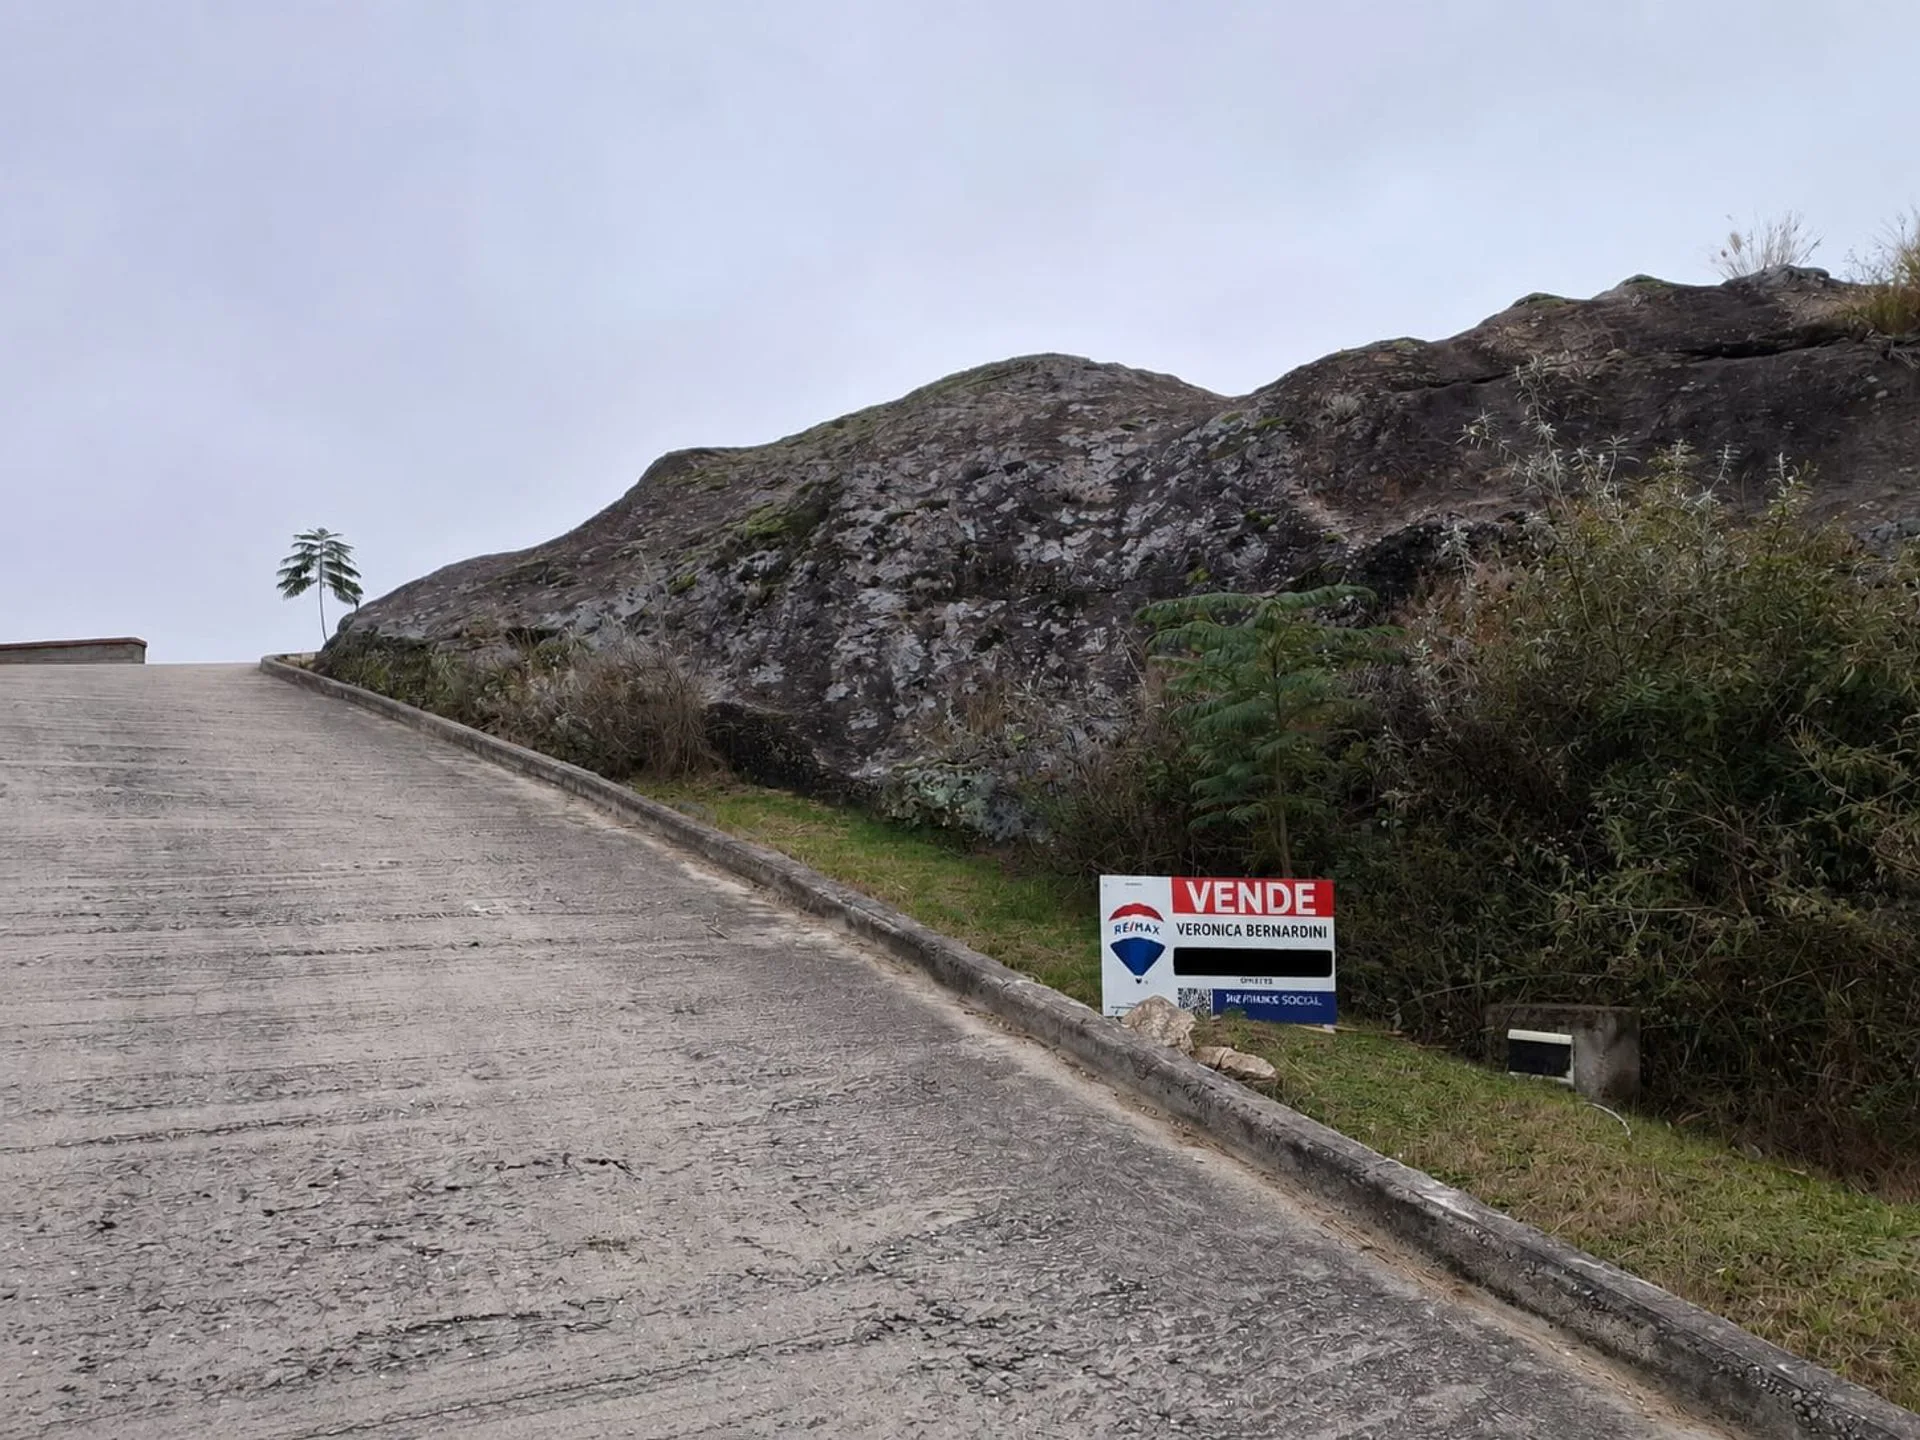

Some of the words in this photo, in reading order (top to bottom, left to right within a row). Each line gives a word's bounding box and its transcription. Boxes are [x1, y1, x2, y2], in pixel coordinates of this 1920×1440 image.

[1186, 881, 1316, 915] VENDE
[1114, 921, 1160, 935] RE/MAX
[1176, 922, 1242, 937] VERONICA
[1246, 924, 1328, 939] BERNARDINI
